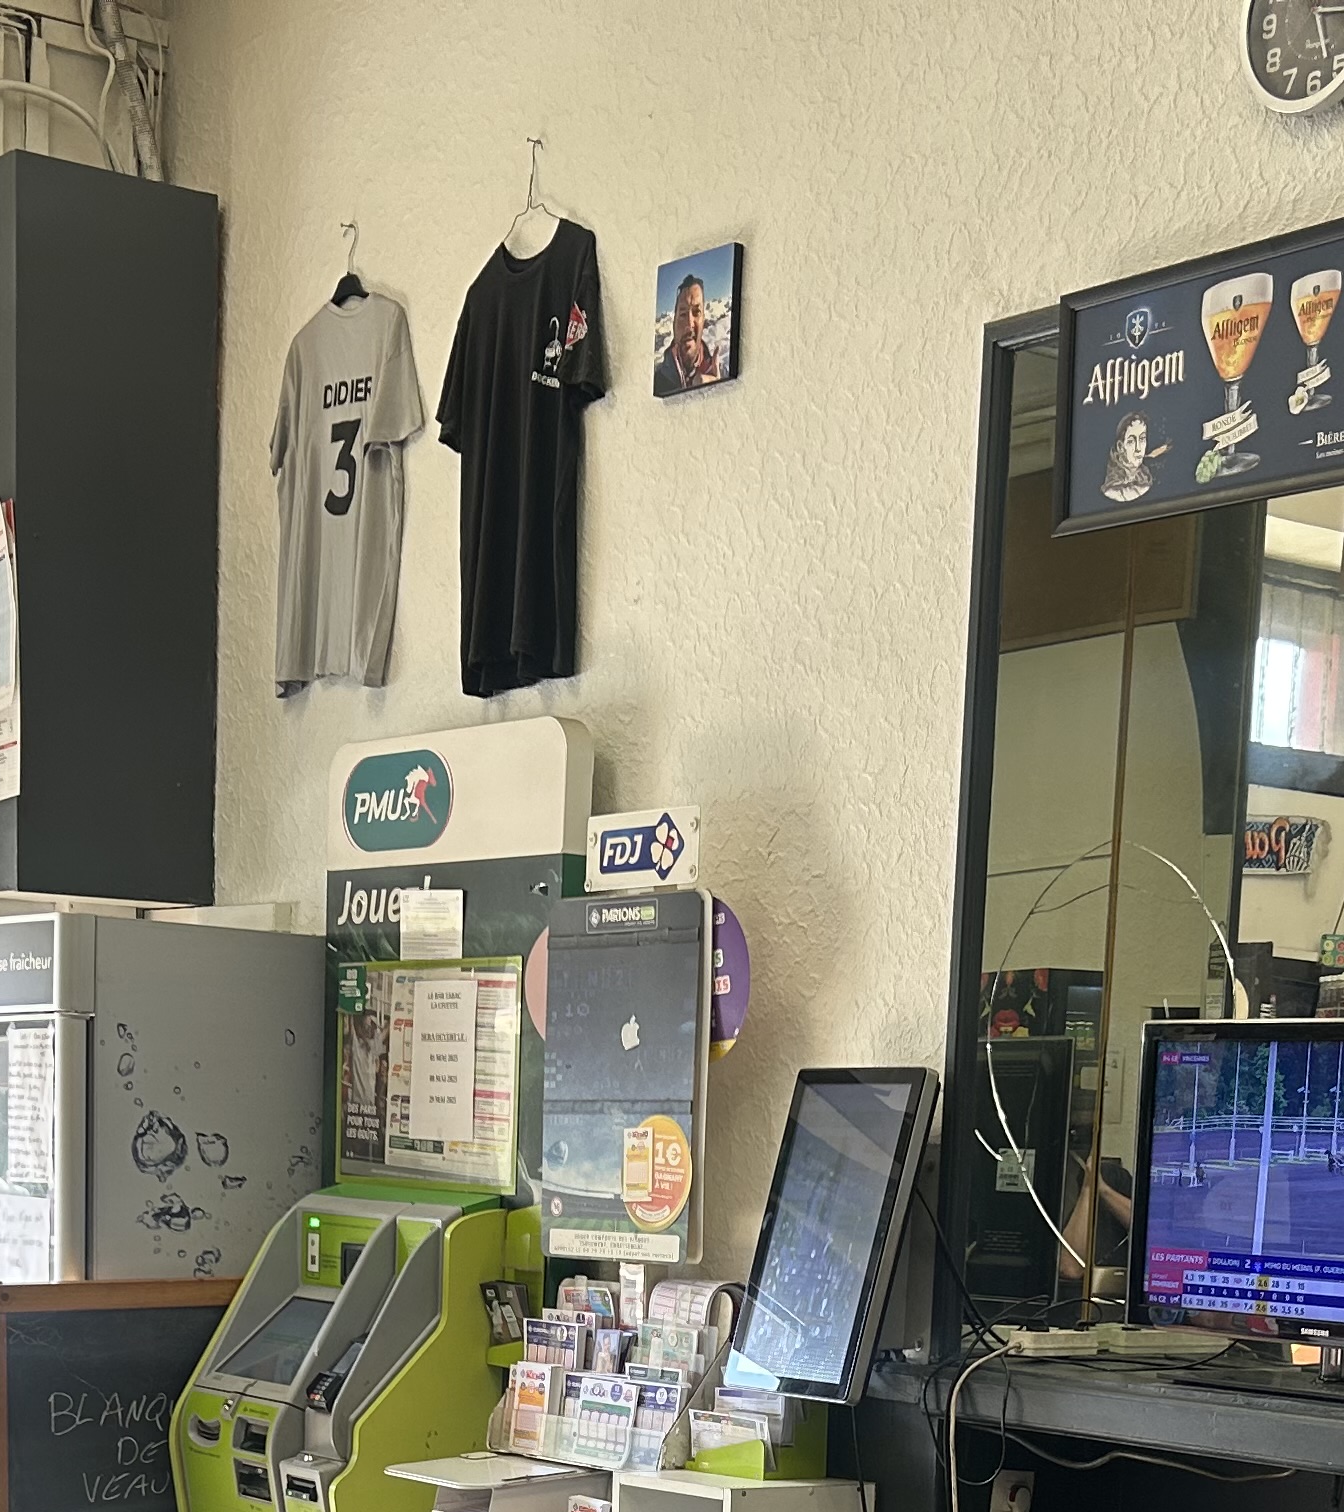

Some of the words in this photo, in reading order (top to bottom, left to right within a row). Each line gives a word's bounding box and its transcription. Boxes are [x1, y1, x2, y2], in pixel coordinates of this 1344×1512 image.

[1262, 13, 1277, 40] 9
[1266, 47, 1281, 73] 8
[1282, 67, 1298, 95] 7
[1307, 70, 1321, 96] 6
[1210, 315, 1260, 341] Affligem
[1082, 350, 1185, 407] Affligem
[324, 418, 362, 516] 3
[353, 786, 405, 825] PMU
[603, 832, 644, 868] FDJ
[9, 951, 52, 971] fraîcheur
[117, 1436, 169, 1466] DE
[82, 1471, 170, 1504] VEAU
